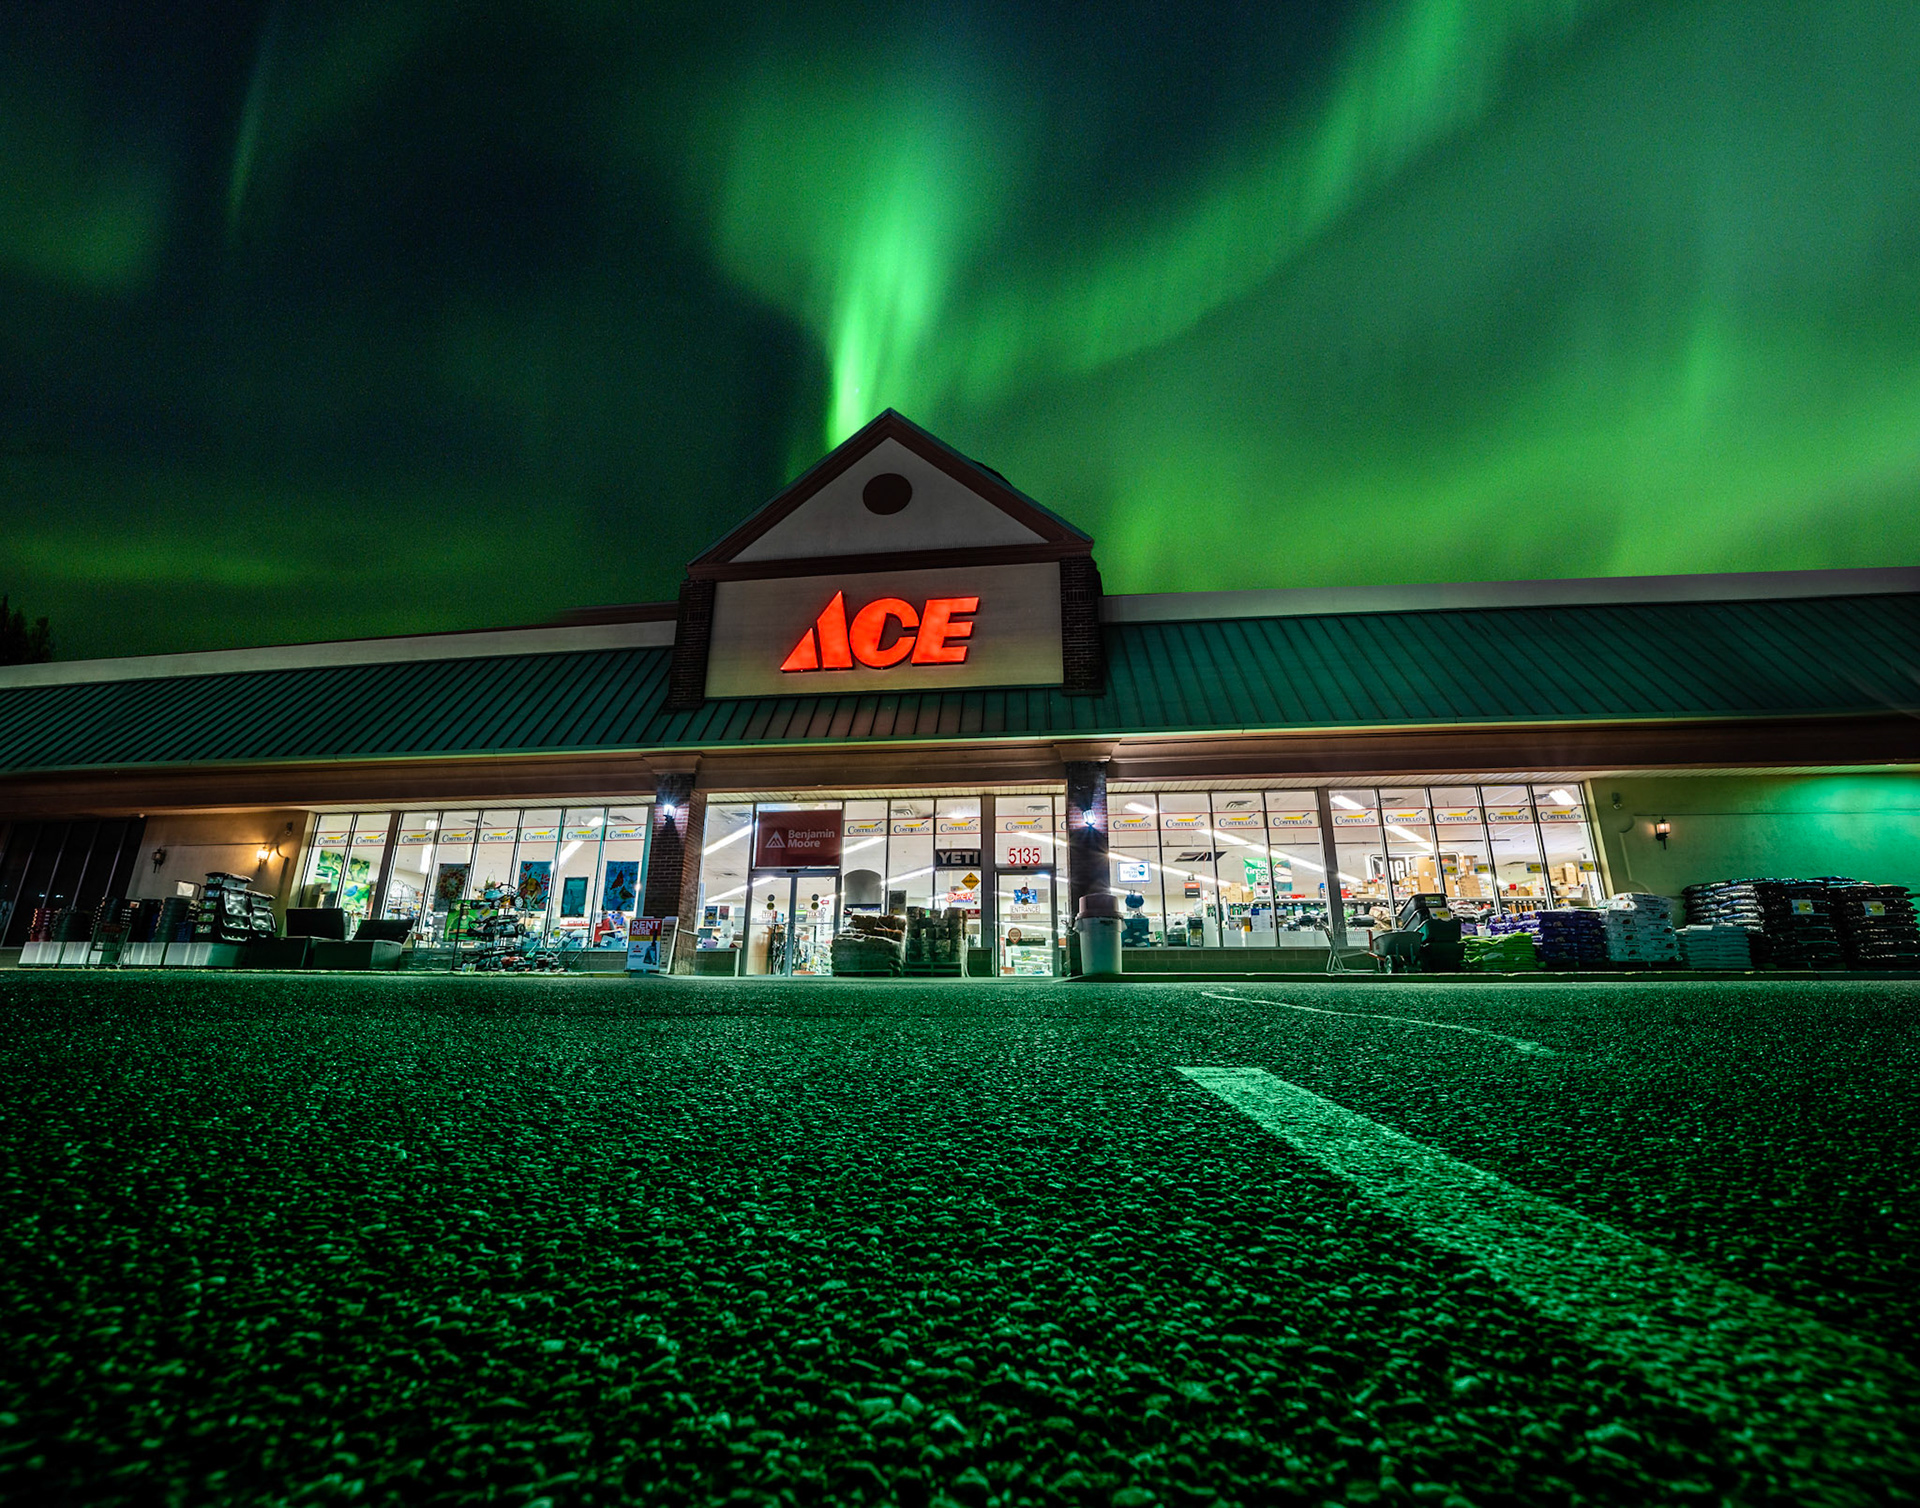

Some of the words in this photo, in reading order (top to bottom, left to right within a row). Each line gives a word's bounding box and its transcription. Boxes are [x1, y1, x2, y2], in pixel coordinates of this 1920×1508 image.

[780, 590, 980, 673] ACE
[788, 829, 835, 840] Benjamin
[787, 839, 820, 848] Moore
[939, 851, 979, 864] YETI
[1008, 847, 1040, 864] 5135
[946, 892, 975, 903] OPEN
[632, 921, 660, 929] RENT
